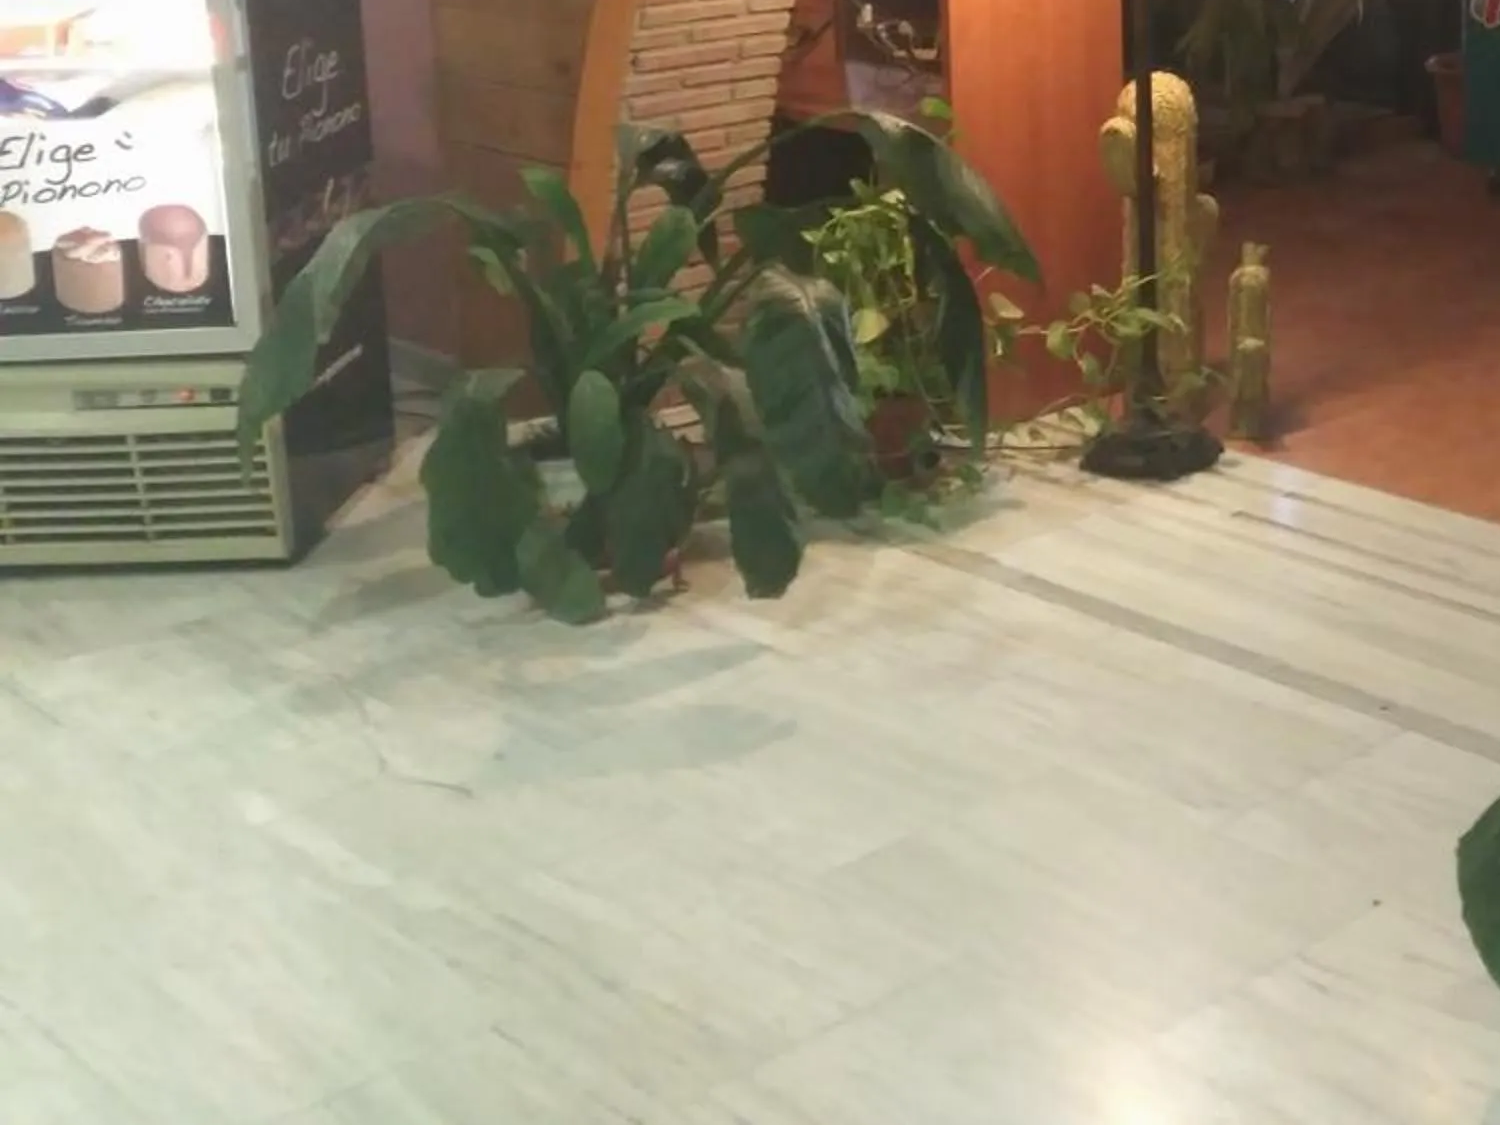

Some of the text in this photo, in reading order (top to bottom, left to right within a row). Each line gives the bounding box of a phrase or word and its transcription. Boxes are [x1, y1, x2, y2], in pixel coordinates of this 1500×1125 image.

[282, 39, 339, 117] Elige
[0, 132, 97, 186] Elige
[0, 176, 147, 208] Pionono
